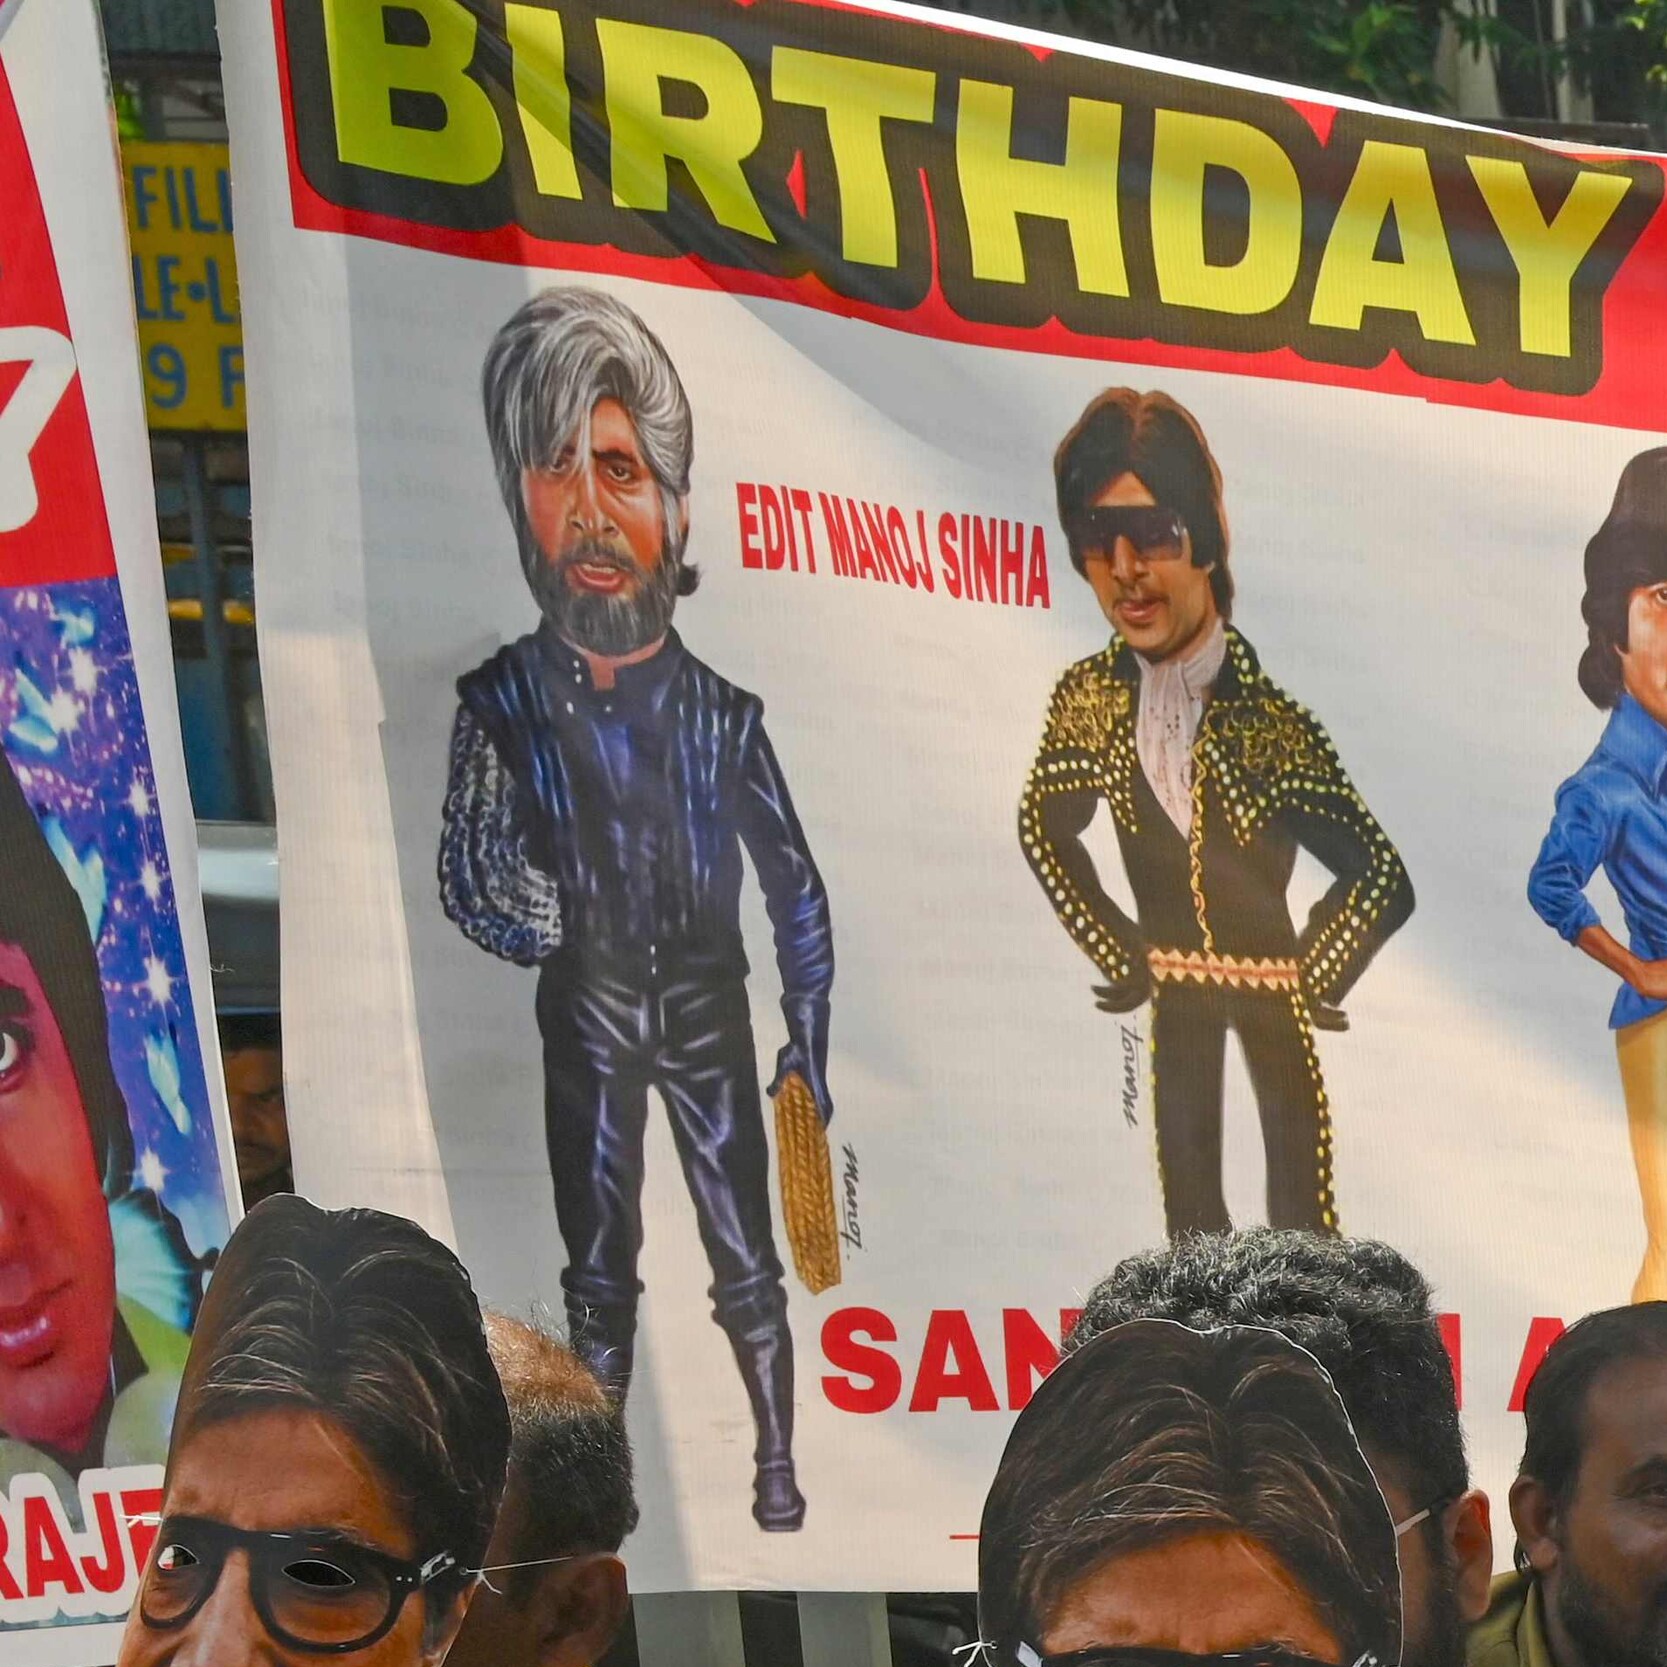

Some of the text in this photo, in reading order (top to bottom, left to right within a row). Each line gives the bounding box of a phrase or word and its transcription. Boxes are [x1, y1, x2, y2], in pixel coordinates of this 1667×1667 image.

[323, 0, 1633, 358] BIRTHDAY
[736, 482, 1050, 609] EDIT MANOJ SINHA
